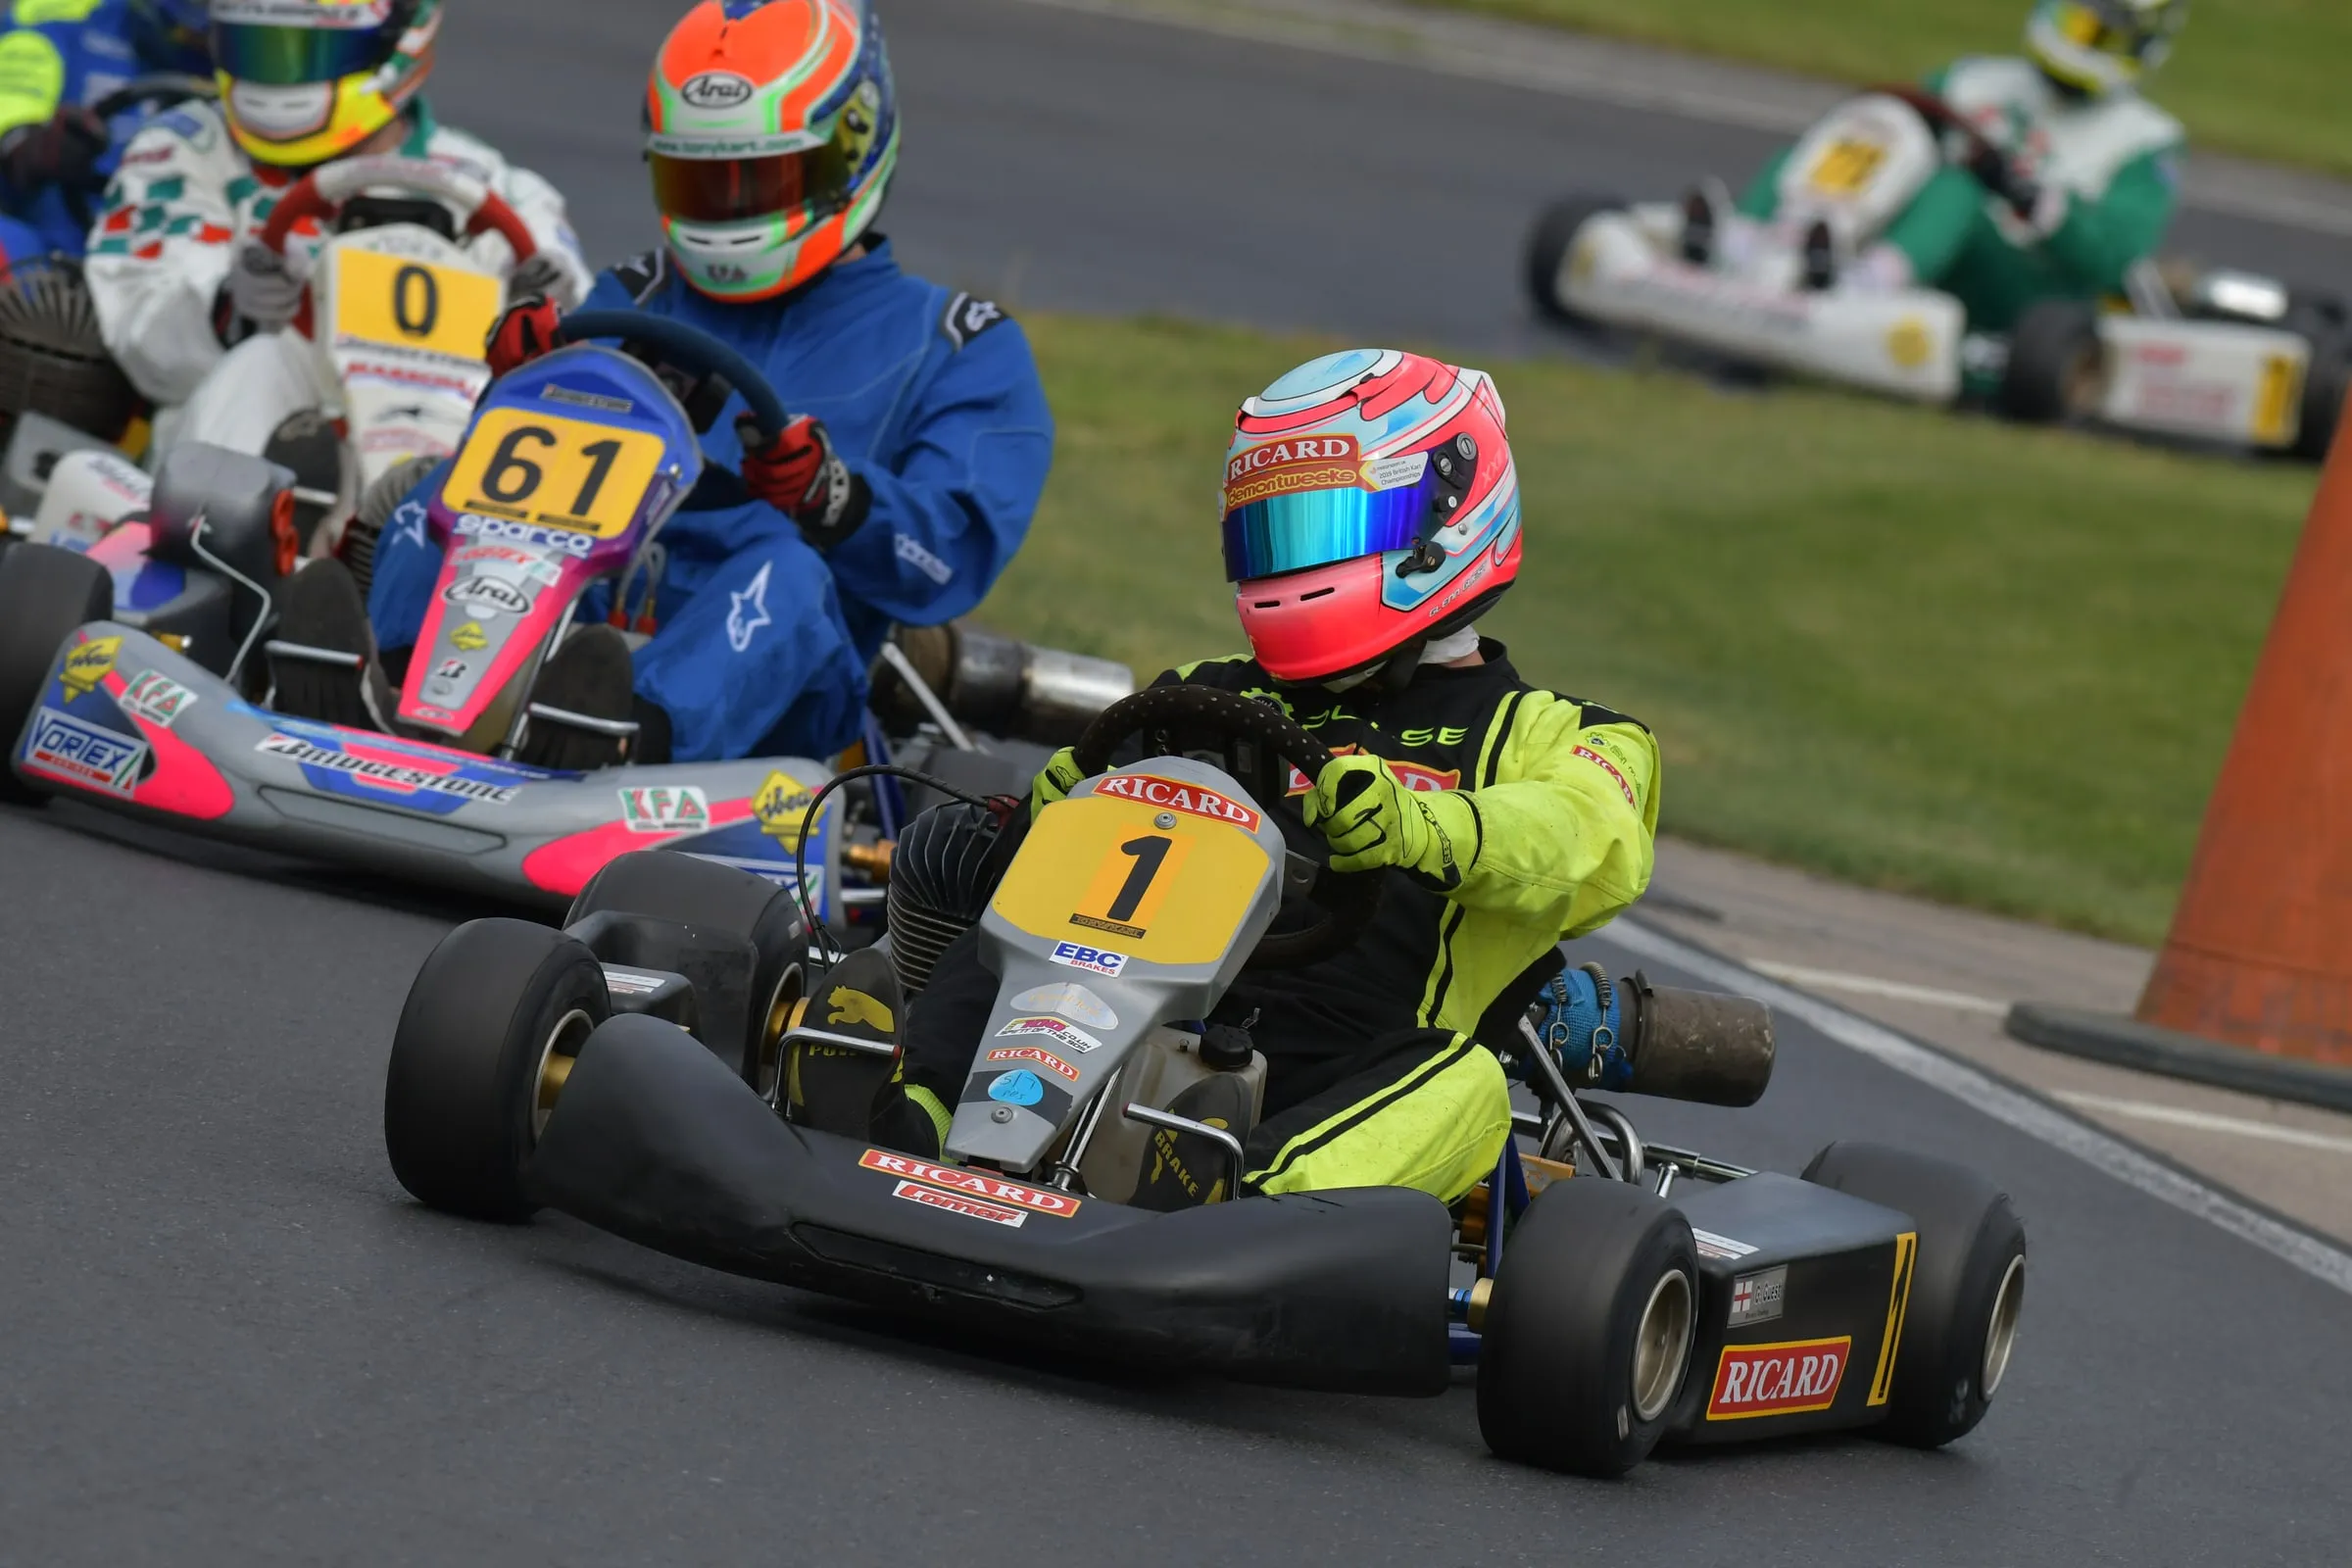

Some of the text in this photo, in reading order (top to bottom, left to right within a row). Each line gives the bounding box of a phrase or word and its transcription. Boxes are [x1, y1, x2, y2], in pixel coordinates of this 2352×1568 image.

[687, 75, 743, 97] Arai
[392, 265, 438, 337] 0
[480, 425, 624, 516] 61
[1230, 439, 1350, 480] RICARD
[453, 513, 595, 559] sparco
[33, 714, 137, 773] VORTEX
[622, 789, 706, 819] KFA
[1102, 778, 1250, 823] RICARD
[1106, 835, 1172, 921] 1
[1054, 943, 1122, 967] EBC
[1070, 958, 1115, 975] BRAKES
[993, 1050, 1074, 1076] RICARD
[873, 1154, 1065, 1210] RICARD
[1154, 1130, 1200, 1198] BRAKE
[1719, 1354, 1838, 1403] RICARD
